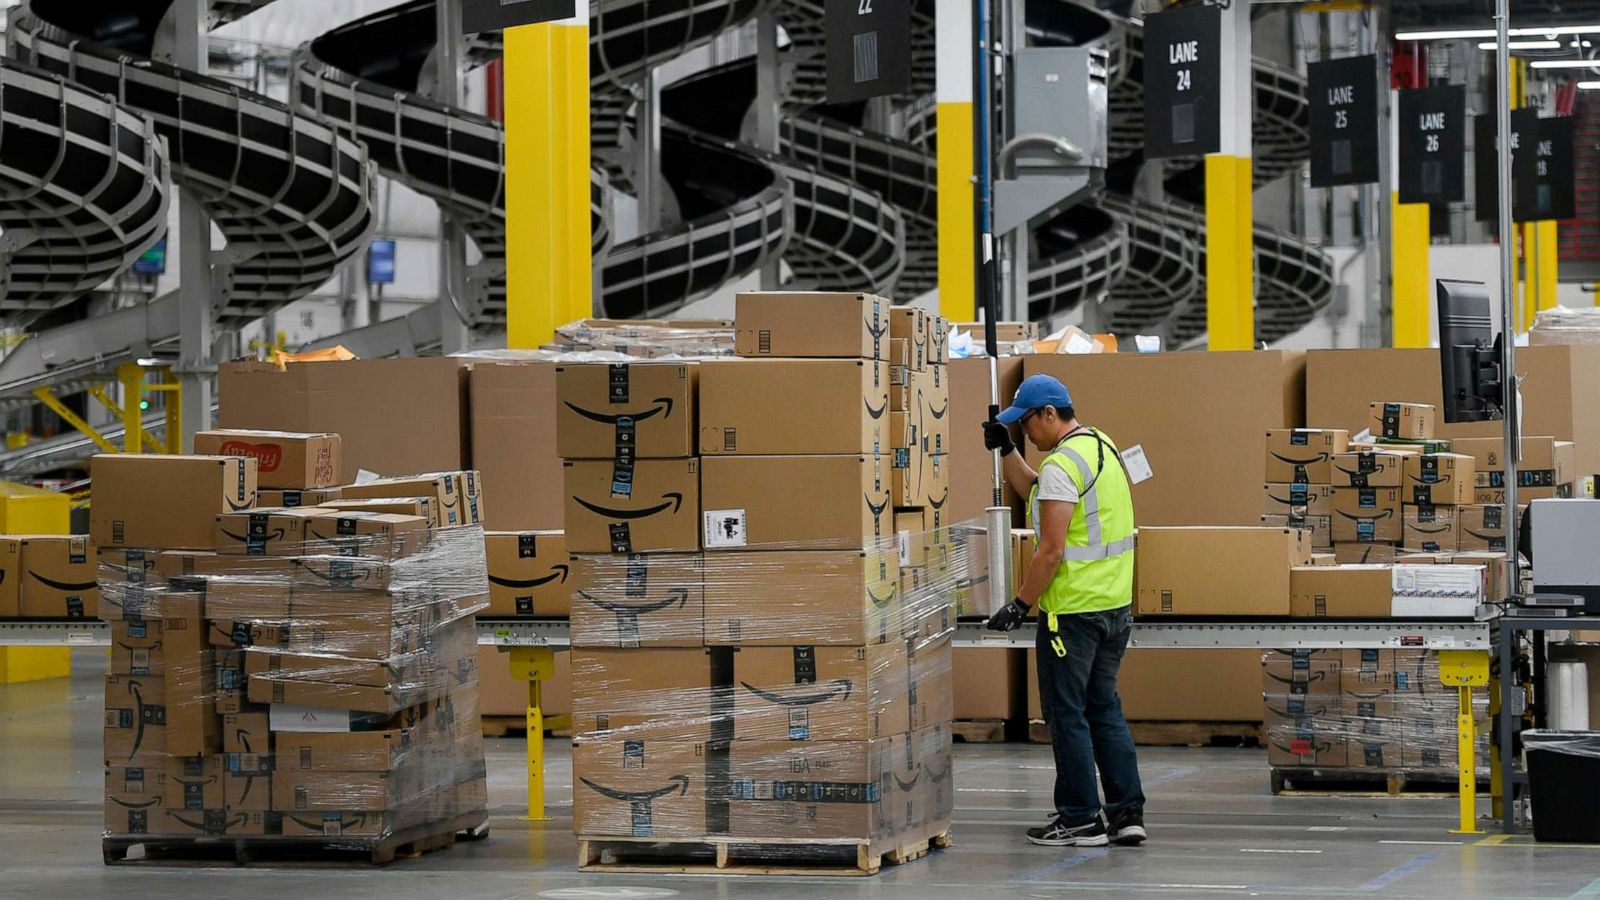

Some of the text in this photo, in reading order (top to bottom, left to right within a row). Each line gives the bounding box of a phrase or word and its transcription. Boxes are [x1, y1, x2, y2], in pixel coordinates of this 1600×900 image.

[1169, 40, 1198, 65] LANE
[1176, 69, 1191, 92] 24
[1328, 85, 1354, 106] LANE
[1335, 110, 1348, 129] 25
[1420, 112, 1445, 131] LANE
[1426, 135, 1439, 152] 26
